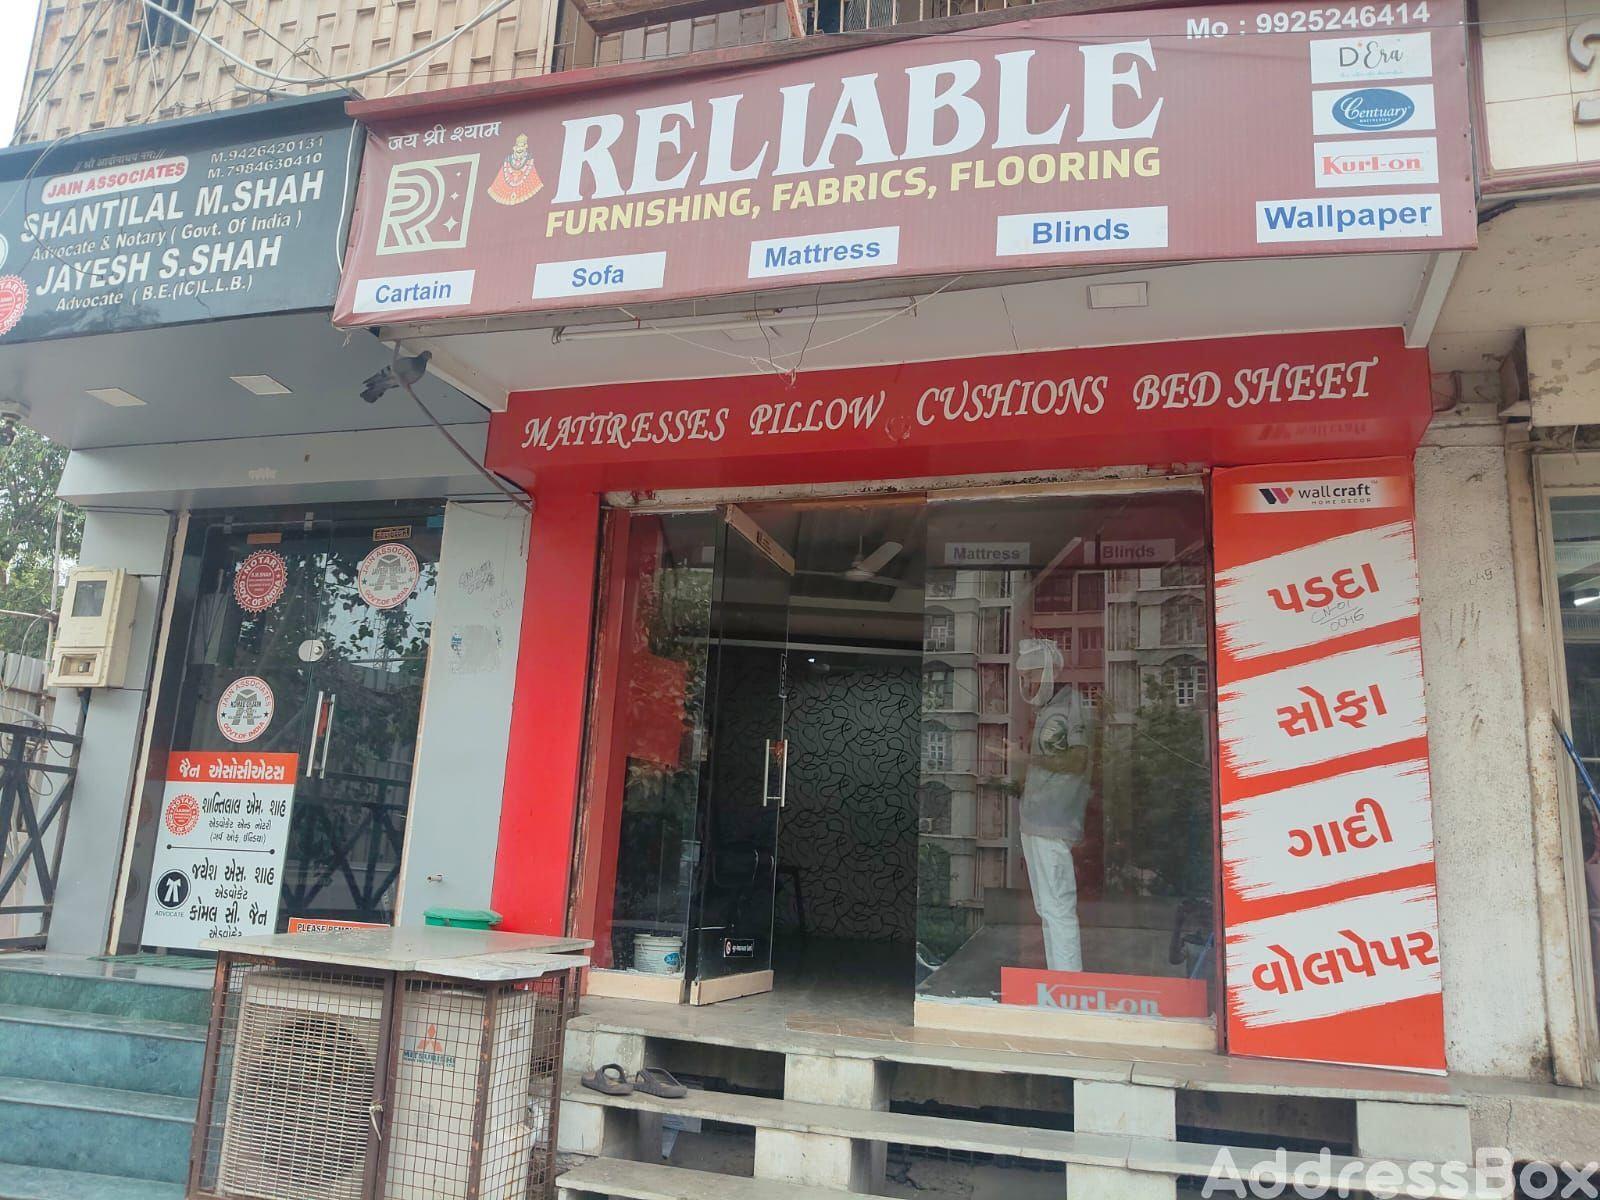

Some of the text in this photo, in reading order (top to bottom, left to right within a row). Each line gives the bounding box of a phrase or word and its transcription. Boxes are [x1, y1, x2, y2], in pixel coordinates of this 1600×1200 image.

[1256, 1, 1431, 34] 9925246414
[550, 38, 1164, 204] RELIABLE
[1340, 96, 1408, 121] Centuary
[388, 121, 503, 152] जय श्री श्याम
[47, 162, 186, 198] JAIN ASSOCIATES
[208, 152, 322, 179] M.7984630410
[20, 170, 325, 243] SHANTILAL M.SHAH
[545, 147, 1161, 238] FURNISHING, FABRICS, FLOORING
[1032, 219, 1130, 245] Blinds
[1264, 204, 1433, 233] Wallpaper
[31, 240, 96, 262] Advocate
[101, 235, 111, 251] &
[116, 229, 167, 249] Notary
[228, 216, 248, 235] Of
[251, 213, 292, 230] India
[36, 235, 283, 297] JAYESH S.SHAH
[764, 239, 881, 269] Mattress
[571, 264, 625, 288] Sofa
[55, 292, 124, 312] Advocate
[375, 280, 452, 304] Cartain
[521, 356, 1380, 451] MATTRESSES PILLOW CUSHIONS BED SHEET
[1298, 483, 1371, 499] wallcraft
[244, 556, 281, 574] NOTARY
[953, 546, 1020, 561] Mattress
[1102, 543, 1155, 559] Blinds
[1267, 562, 1380, 614] પડદા
[1276, 683, 1388, 737] સોફા
[180, 757, 200, 778] જૈન
[269, 799, 287, 818] શાહ
[1287, 797, 1393, 858] ગાદી
[191, 856, 218, 881] જયેશ
[254, 866, 275, 886] શાહ
[189, 895, 218, 923] કોમલ
[248, 901, 268, 926] જૈન
[1251, 928, 1440, 995] વોલપેપર
